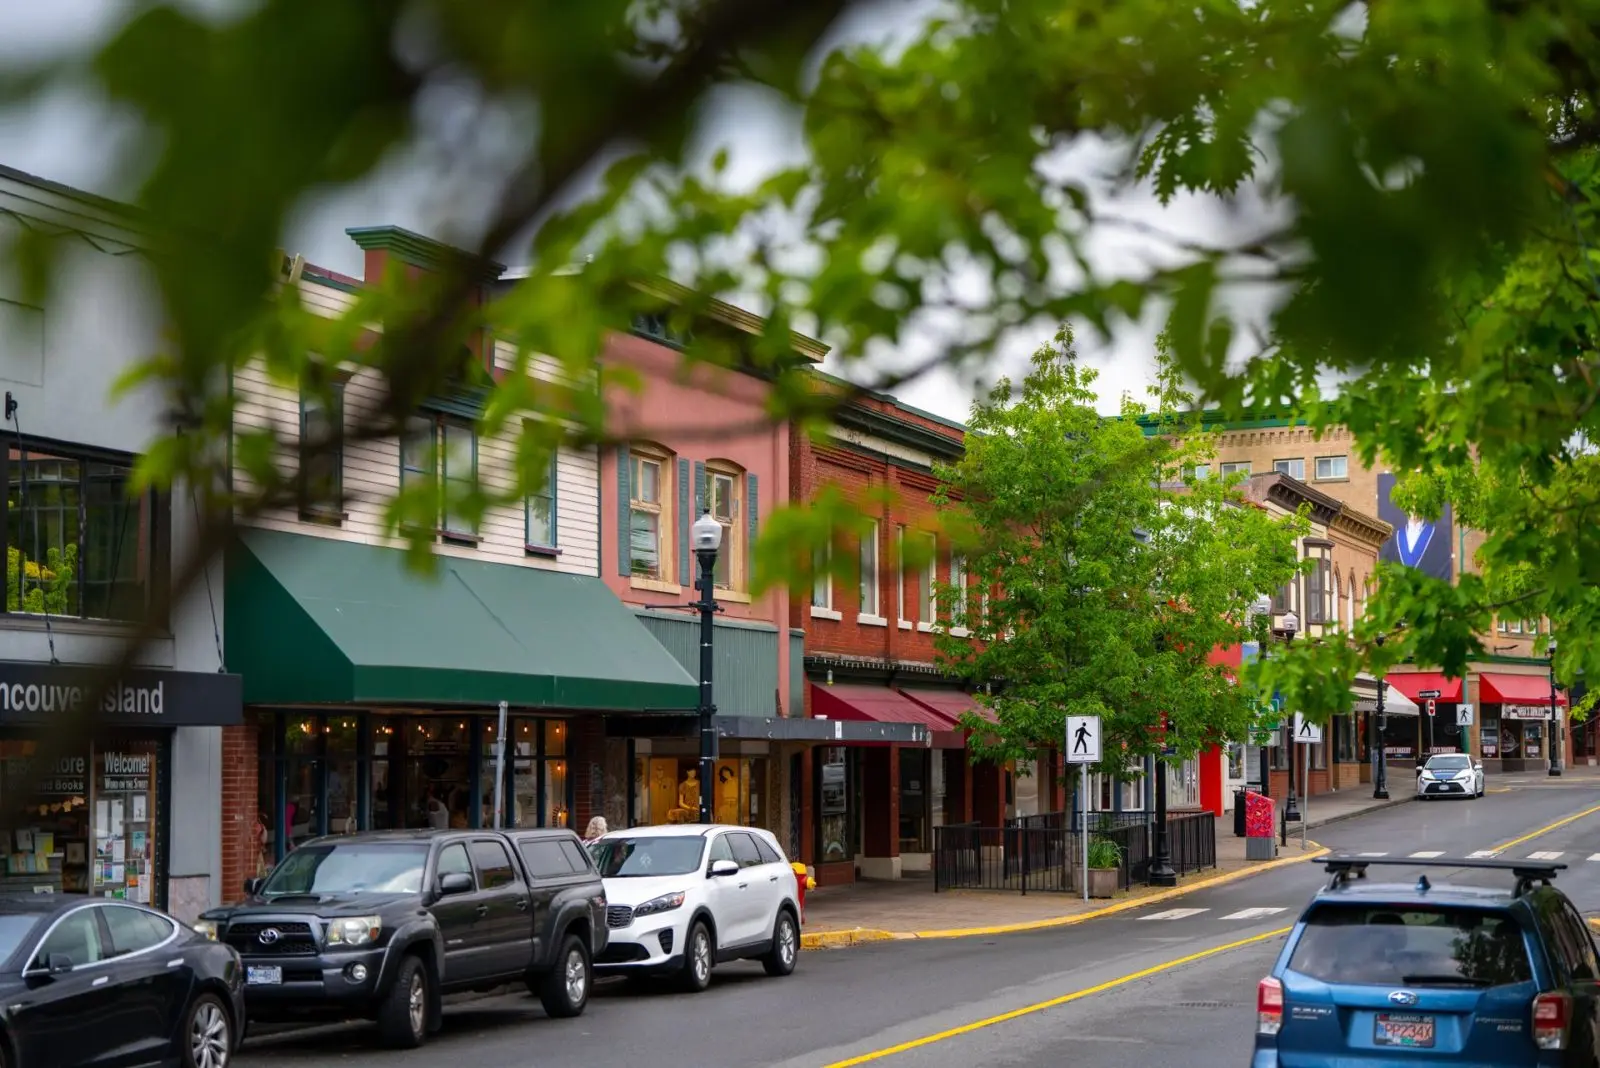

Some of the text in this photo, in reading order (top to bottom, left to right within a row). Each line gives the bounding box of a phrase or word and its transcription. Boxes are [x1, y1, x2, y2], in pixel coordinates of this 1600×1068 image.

[0, 682, 90, 712] ncouve
[104, 751, 150, 773] Welcome!
[55, 779, 84, 790] Books
[1385, 1023, 1432, 1038] PP234X
